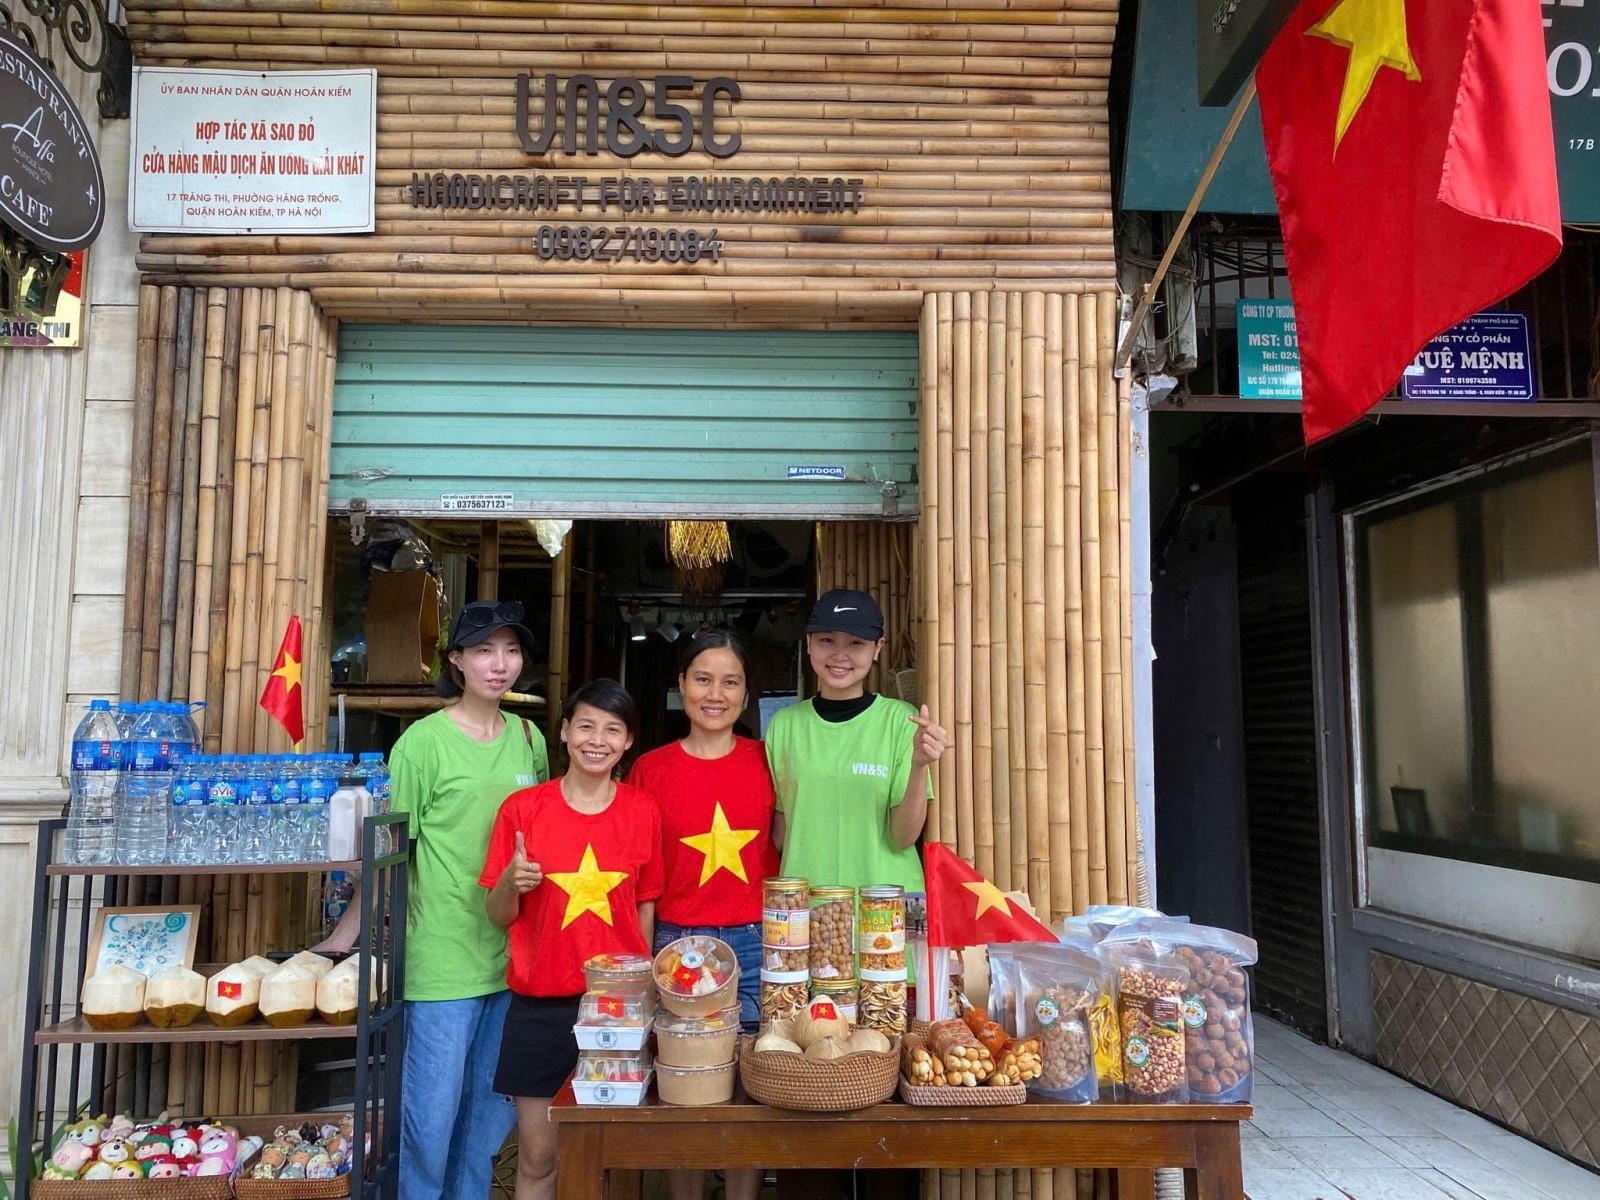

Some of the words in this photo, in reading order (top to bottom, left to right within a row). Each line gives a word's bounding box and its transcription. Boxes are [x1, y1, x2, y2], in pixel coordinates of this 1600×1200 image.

[177, 86, 198, 95] BAN
[201, 85, 232, 95] NHÂN
[235, 86, 258, 96] DÂN
[261, 86, 291, 98] QUẬN
[328, 85, 352, 97] KIẾM
[0, 49, 88, 159] ESTAURANT
[515, 73, 742, 158] VN&5C
[196, 121, 220, 144] HỢP
[224, 118, 246, 140] TÁC
[250, 120, 267, 140] XÃ
[270, 122, 294, 141] SAO
[298, 116, 315, 141] ĐỎ
[1568, 138, 1594, 150] 17B
[143, 146, 165, 174] CỬA
[168, 149, 198, 174] HÀNG
[202, 150, 227, 179] MẬU
[230, 154, 257, 179] DỊCH
[260, 151, 275, 175] ĂN
[337, 151, 365, 175] KHÁT
[167, 193, 176, 202] 17
[179, 192, 212, 202] TRÀNG
[233, 192, 274, 203] PHƯỜNG
[276, 192, 304, 203] HÀNG
[411, 171, 588, 212] HANDICRAFT
[600, 176, 655, 212] FOR
[667, 176, 864, 214] ENVIRONMENT
[186, 206, 215, 218] QUẬN
[218, 206, 246, 216] HOÀN
[277, 208, 286, 216] TP
[288, 207, 301, 216] HÀ
[304, 207, 321, 218] NỘI
[536, 225, 718, 263] 0982719084
[0, 318, 39, 338] ÀNG
[43, 322, 70, 338] THI
[1248, 334, 1280, 347] MST:
[1284, 335, 1299, 347] 01
[1451, 335, 1464, 343] TY
[1261, 351, 1278, 359] Tel:
[1280, 351, 1300, 360] 024.
[1413, 346, 1454, 374] TUỆ
[1460, 346, 1525, 374] MỆNH
[456, 500, 506, 509] 0375637123
[211, 786, 236, 796] aVie
